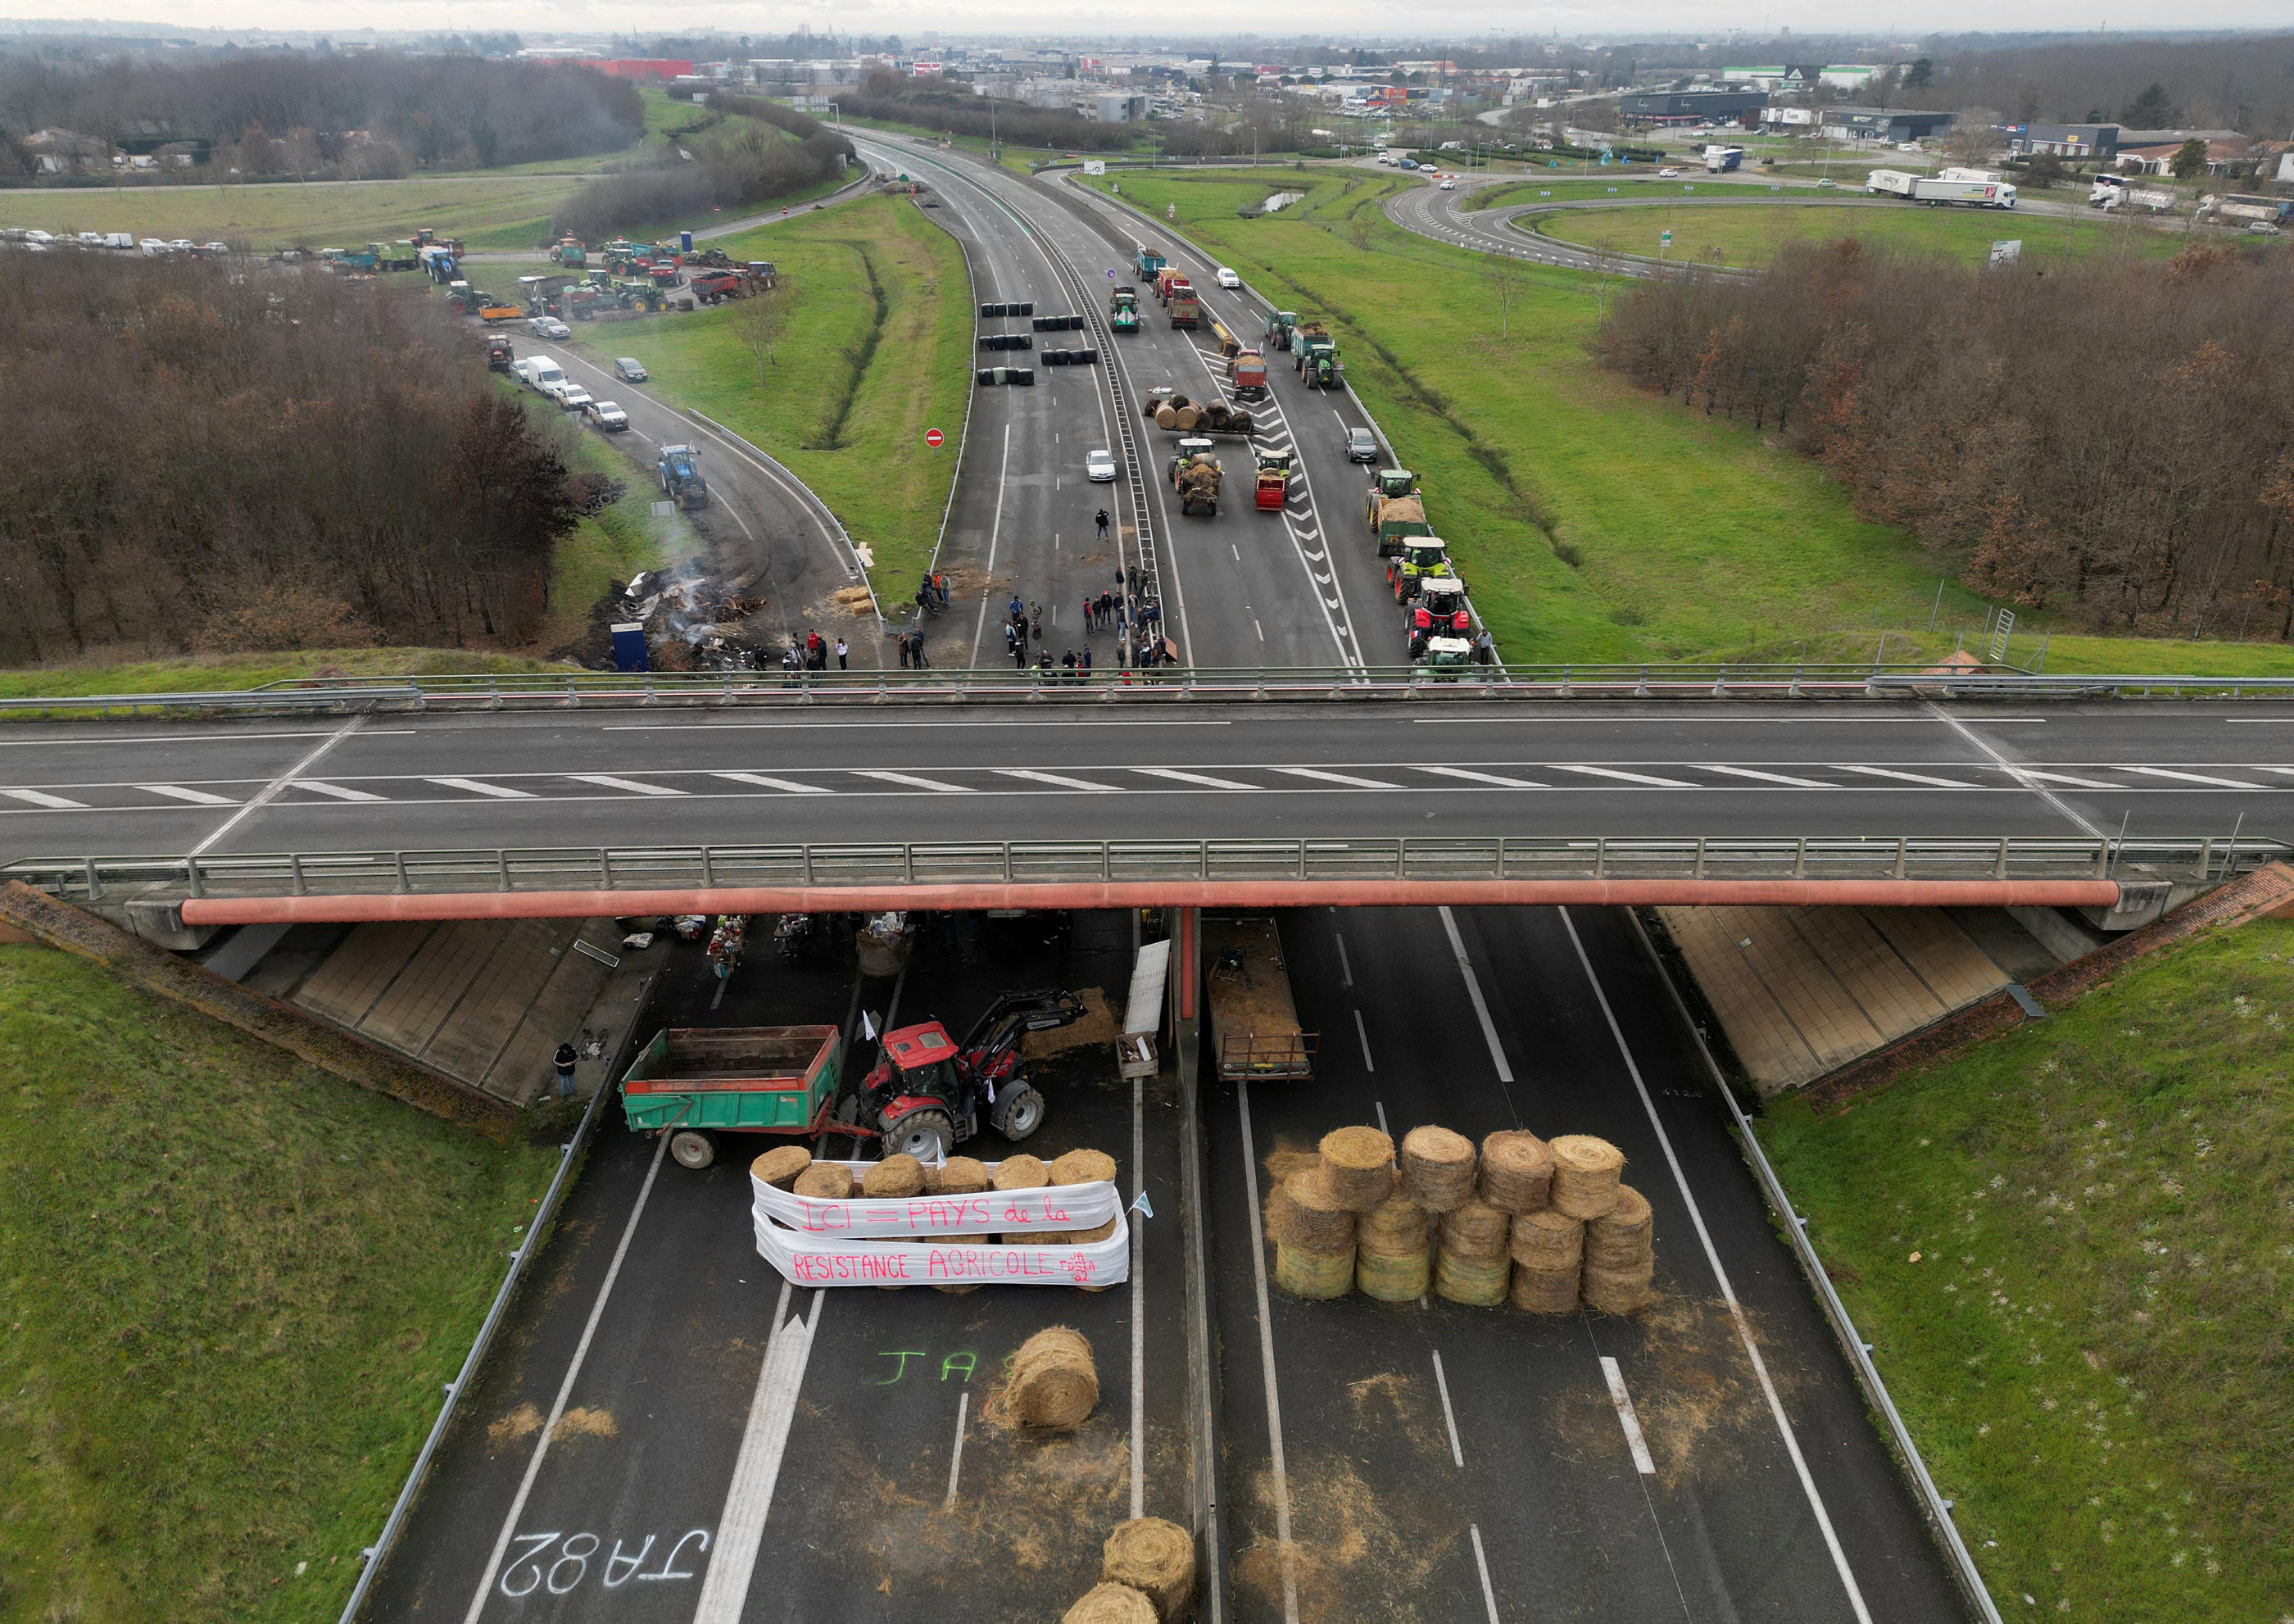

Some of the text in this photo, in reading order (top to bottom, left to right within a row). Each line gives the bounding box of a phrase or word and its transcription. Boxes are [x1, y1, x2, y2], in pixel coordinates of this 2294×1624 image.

[797, 1201, 850, 1231] ICI
[909, 1200, 990, 1228] PAYS
[1004, 1200, 1031, 1223] de
[1042, 1195, 1071, 1222] la
[794, 1249, 1054, 1281] RESISTANCE AGRICOLE
[1070, 1252, 1085, 1261] JA
